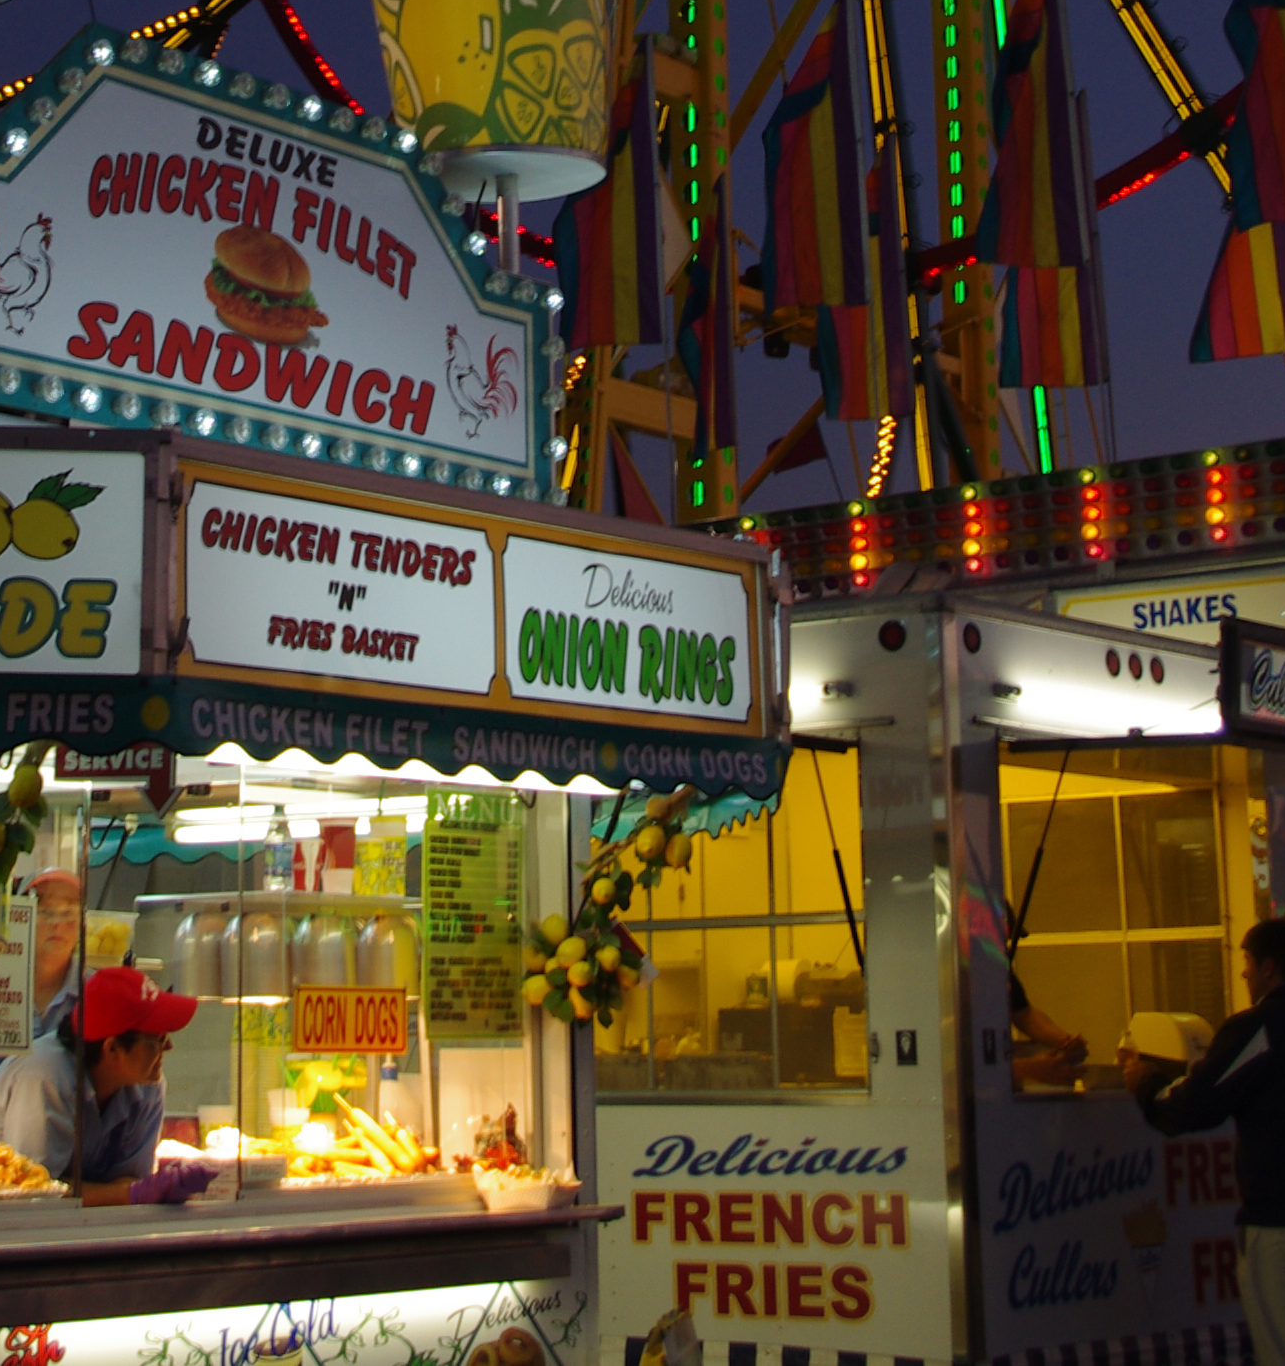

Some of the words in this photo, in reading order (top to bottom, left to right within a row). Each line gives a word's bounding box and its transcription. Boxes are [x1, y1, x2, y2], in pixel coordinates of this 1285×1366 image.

[196, 115, 338, 189] DELUXE
[87, 151, 280, 236] CHICKEN
[291, 186, 418, 301] FILLET
[67, 300, 437, 436] SANDWICH
[200, 507, 341, 566] CHICKEN
[350, 530, 477, 588] TENDERS
[582, 563, 675, 617] Delicious
[1132, 593, 1239, 632] SHAKES
[267, 615, 334, 652] FRIES
[341, 624, 420, 663] BASKET
[519, 608, 628, 694] ONION
[639, 625, 737, 706] RINGS
[11, 693, 116, 734] FRIES
[190, 697, 335, 751] CHICKEN
[344, 712, 428, 756] FILET
[452, 724, 597, 774] SANDWICH
[622, 746, 694, 780] CORN
[699, 749, 769, 785] DOGS
[63, 747, 166, 772] SERVICE
[433, 792, 515, 825] MENU
[302, 994, 348, 1046] CORN
[354, 995, 399, 1047] DOGS
[631, 1132, 909, 1179] Delicious
[631, 1189, 910, 1250] FRENCH
[992, 1144, 1155, 1235] Delicious
[673, 1260, 875, 1321] FRIES
[1007, 1239, 1119, 1310] Cullers
[445, 1287, 562, 1342] Delicious
